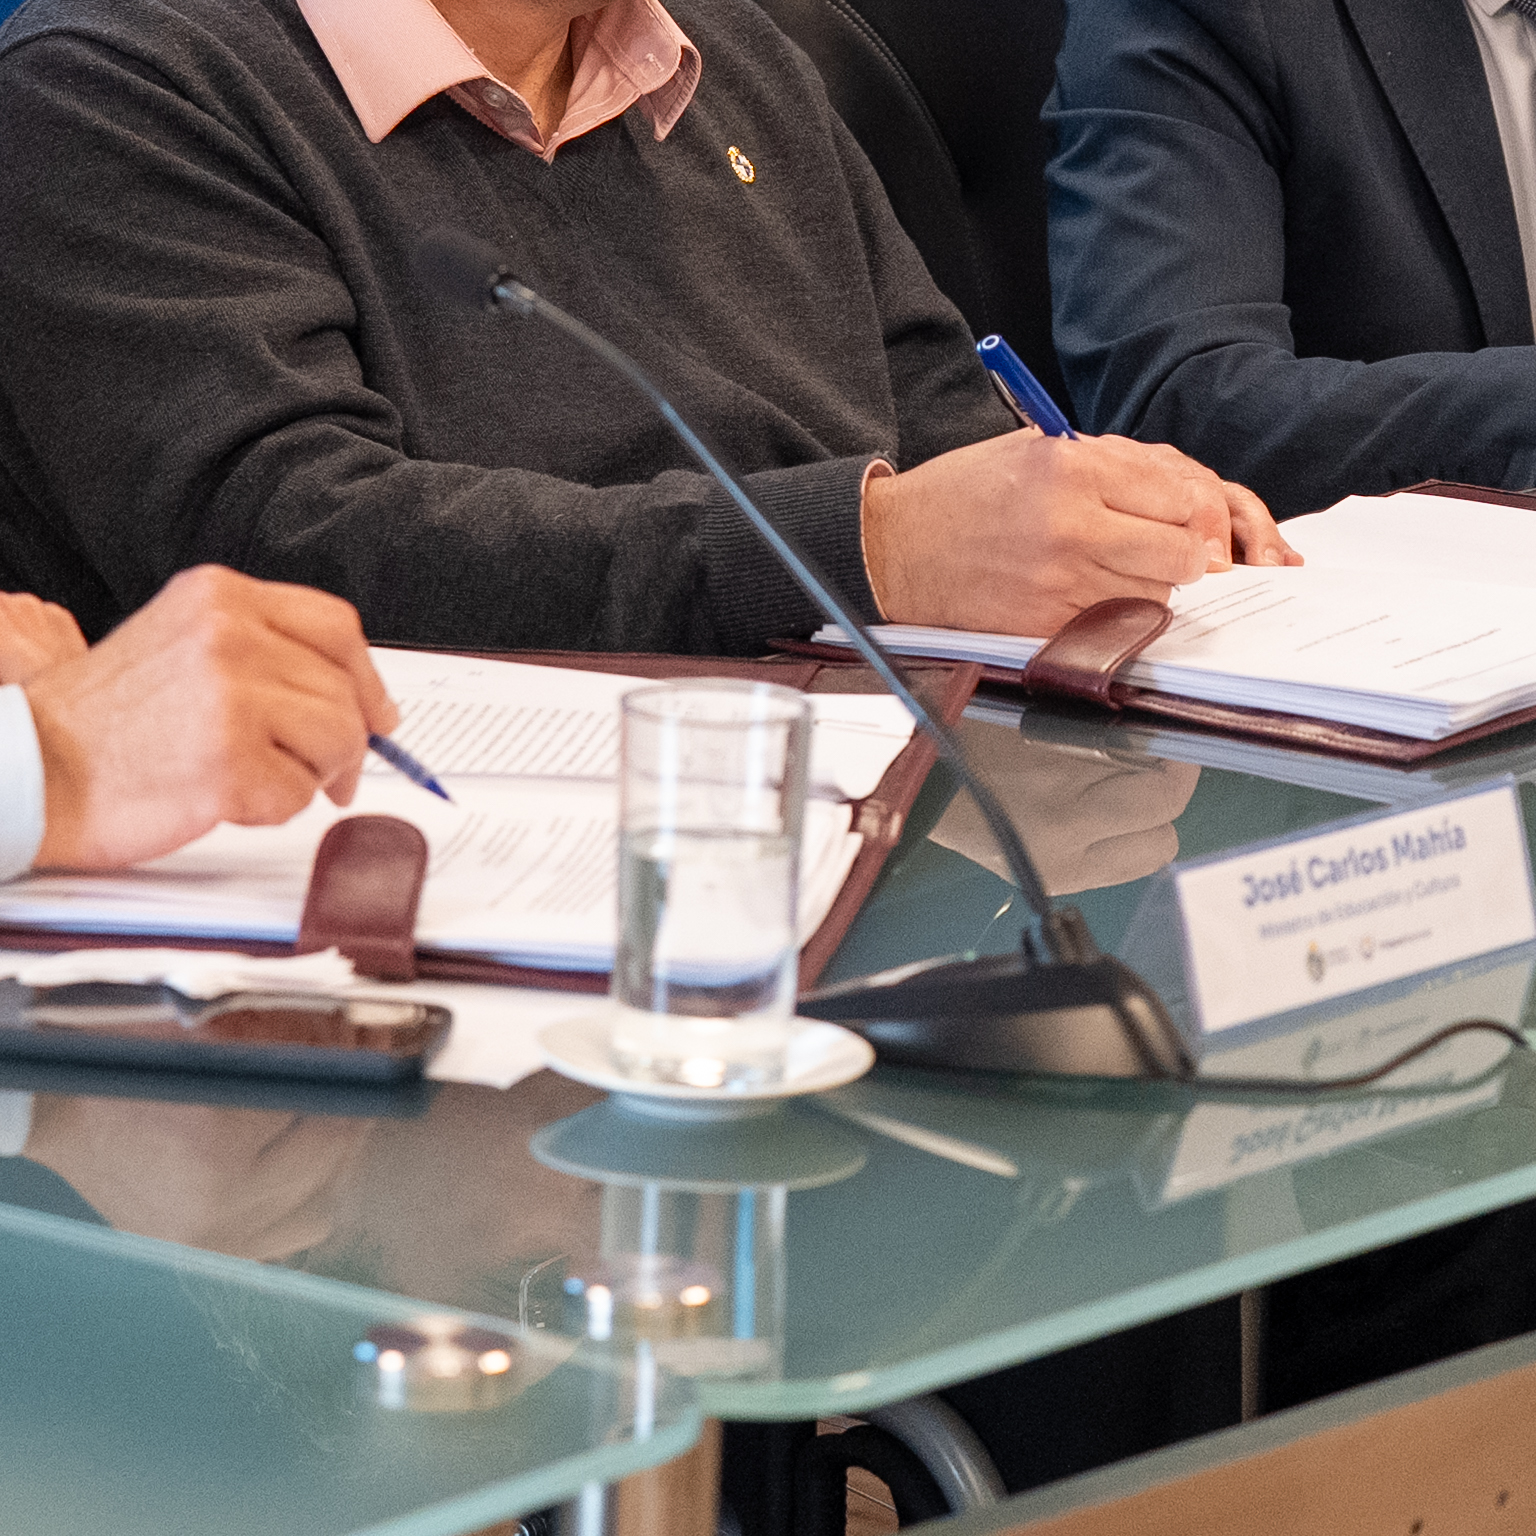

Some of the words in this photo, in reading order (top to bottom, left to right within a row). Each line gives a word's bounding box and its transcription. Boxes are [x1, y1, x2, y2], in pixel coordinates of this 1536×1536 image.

[1242, 856, 1302, 909] José
[1307, 846, 1389, 890] Carlos
[1391, 818, 1466, 866] Mahía
